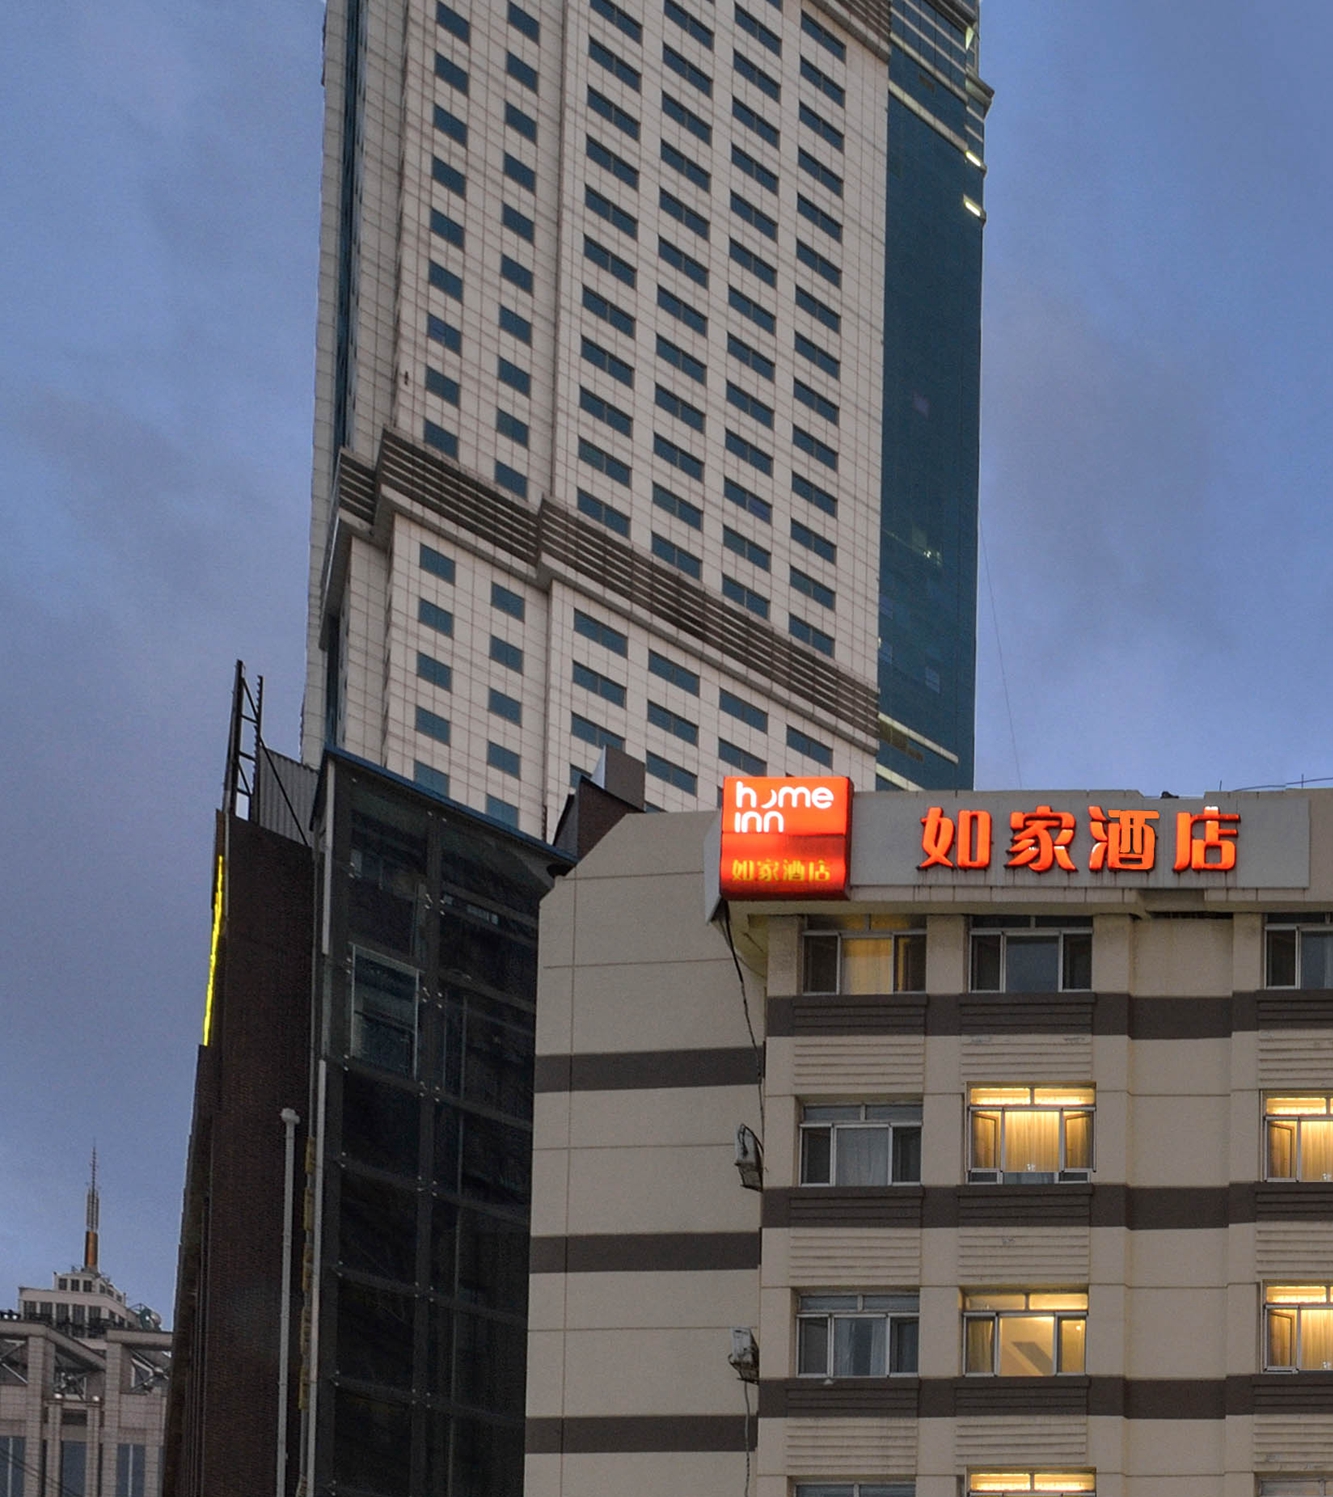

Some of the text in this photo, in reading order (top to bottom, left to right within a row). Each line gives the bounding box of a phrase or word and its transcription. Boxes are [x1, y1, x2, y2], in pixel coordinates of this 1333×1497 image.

[734, 811, 784, 833] inn
[919, 805, 1242, 873] 如家酒店
[732, 858, 831, 882] 如家酒店
